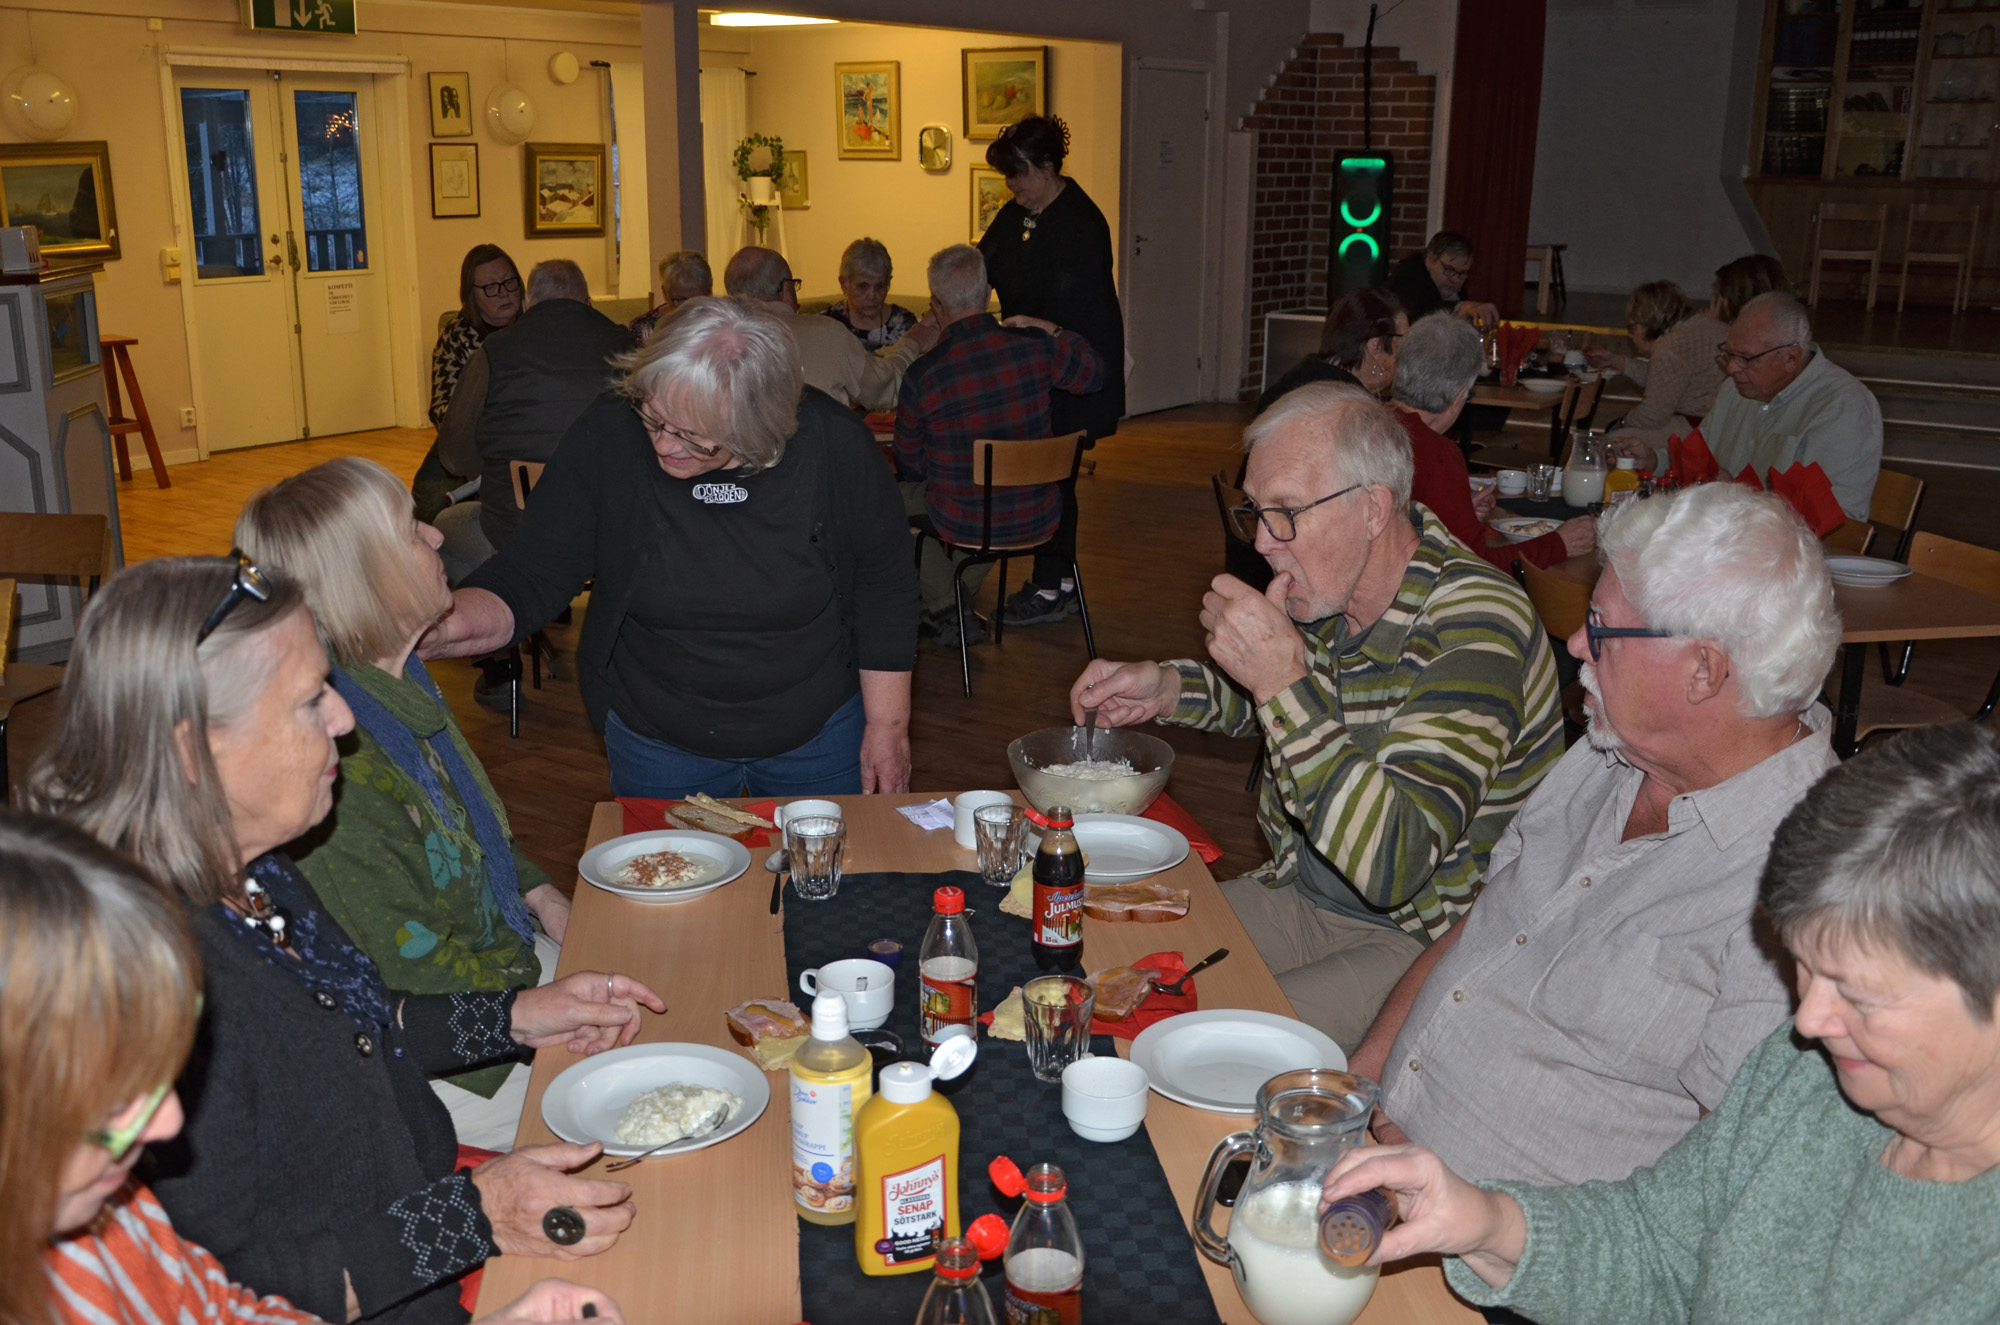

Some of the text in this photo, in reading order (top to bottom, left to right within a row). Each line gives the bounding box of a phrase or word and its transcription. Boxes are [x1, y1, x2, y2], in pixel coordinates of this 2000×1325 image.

[888, 1170, 940, 1202] Johnny's
[897, 1200, 934, 1216] SENAP
[893, 1210, 937, 1226] SÖTSTARK
